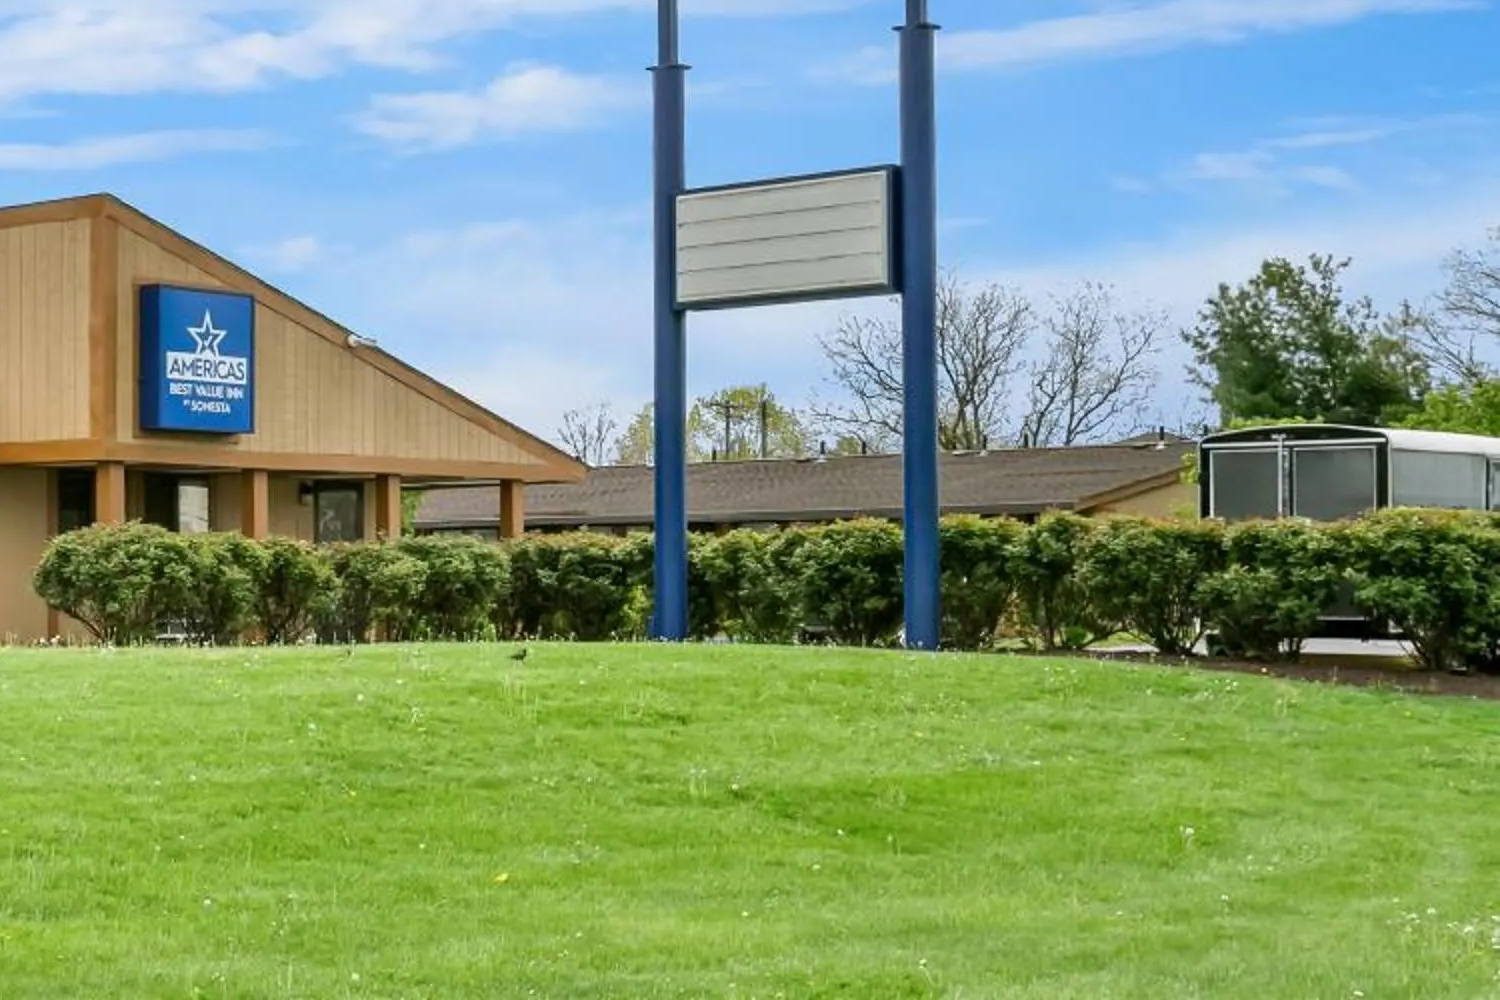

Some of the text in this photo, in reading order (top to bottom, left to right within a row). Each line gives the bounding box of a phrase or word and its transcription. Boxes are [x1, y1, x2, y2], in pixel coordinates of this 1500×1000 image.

[169, 357, 245, 380] AMERICAS
[169, 382, 244, 400] BEST VALUE INN
[191, 400, 231, 413] SONESTA
